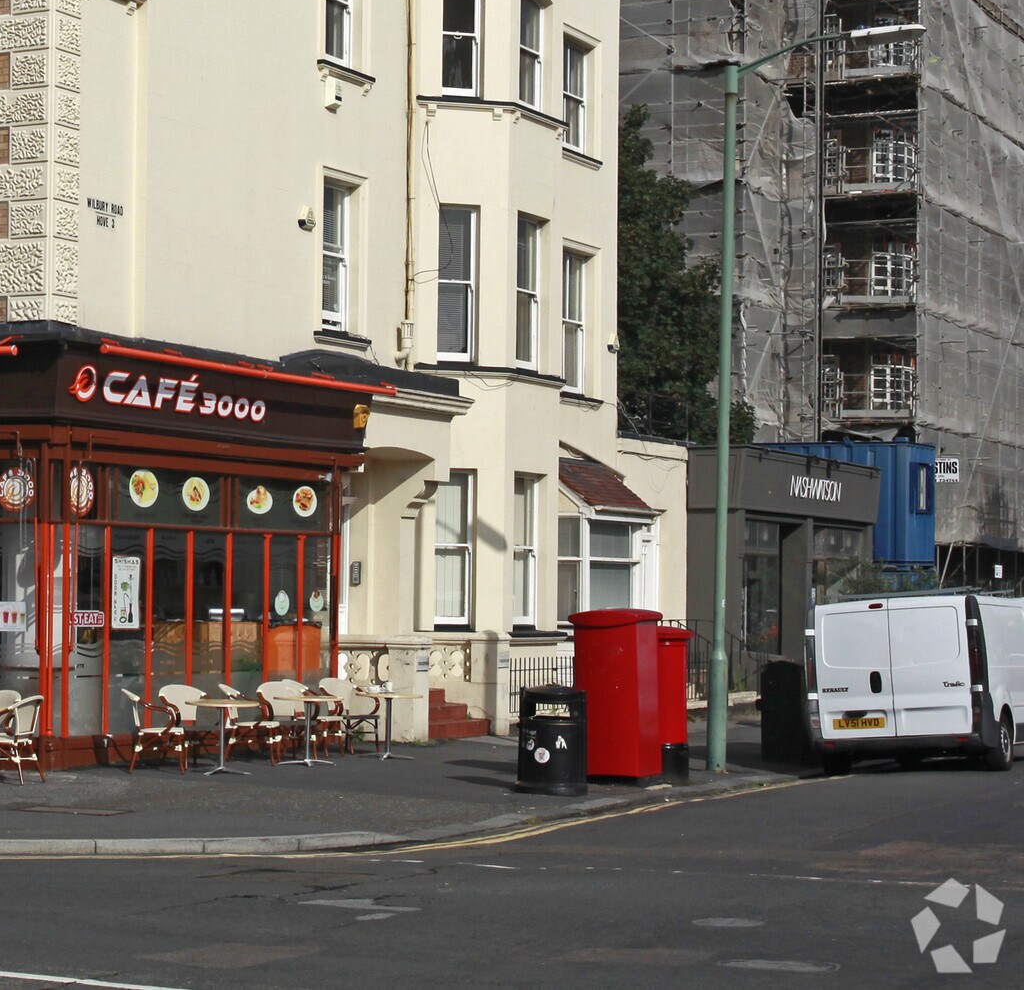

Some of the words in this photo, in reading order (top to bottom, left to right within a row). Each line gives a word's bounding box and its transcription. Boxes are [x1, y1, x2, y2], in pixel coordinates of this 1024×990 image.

[87, 197, 109, 212] WILBURY
[111, 203, 123, 216] ROAD
[96, 215, 109, 227] HOVE
[102, 372, 200, 413] CAFÉ
[198, 392, 266, 422] 3000
[84, 613, 98, 624] EAT
[838, 718, 859, 728] LV51
[861, 717, 880, 727] HVD
